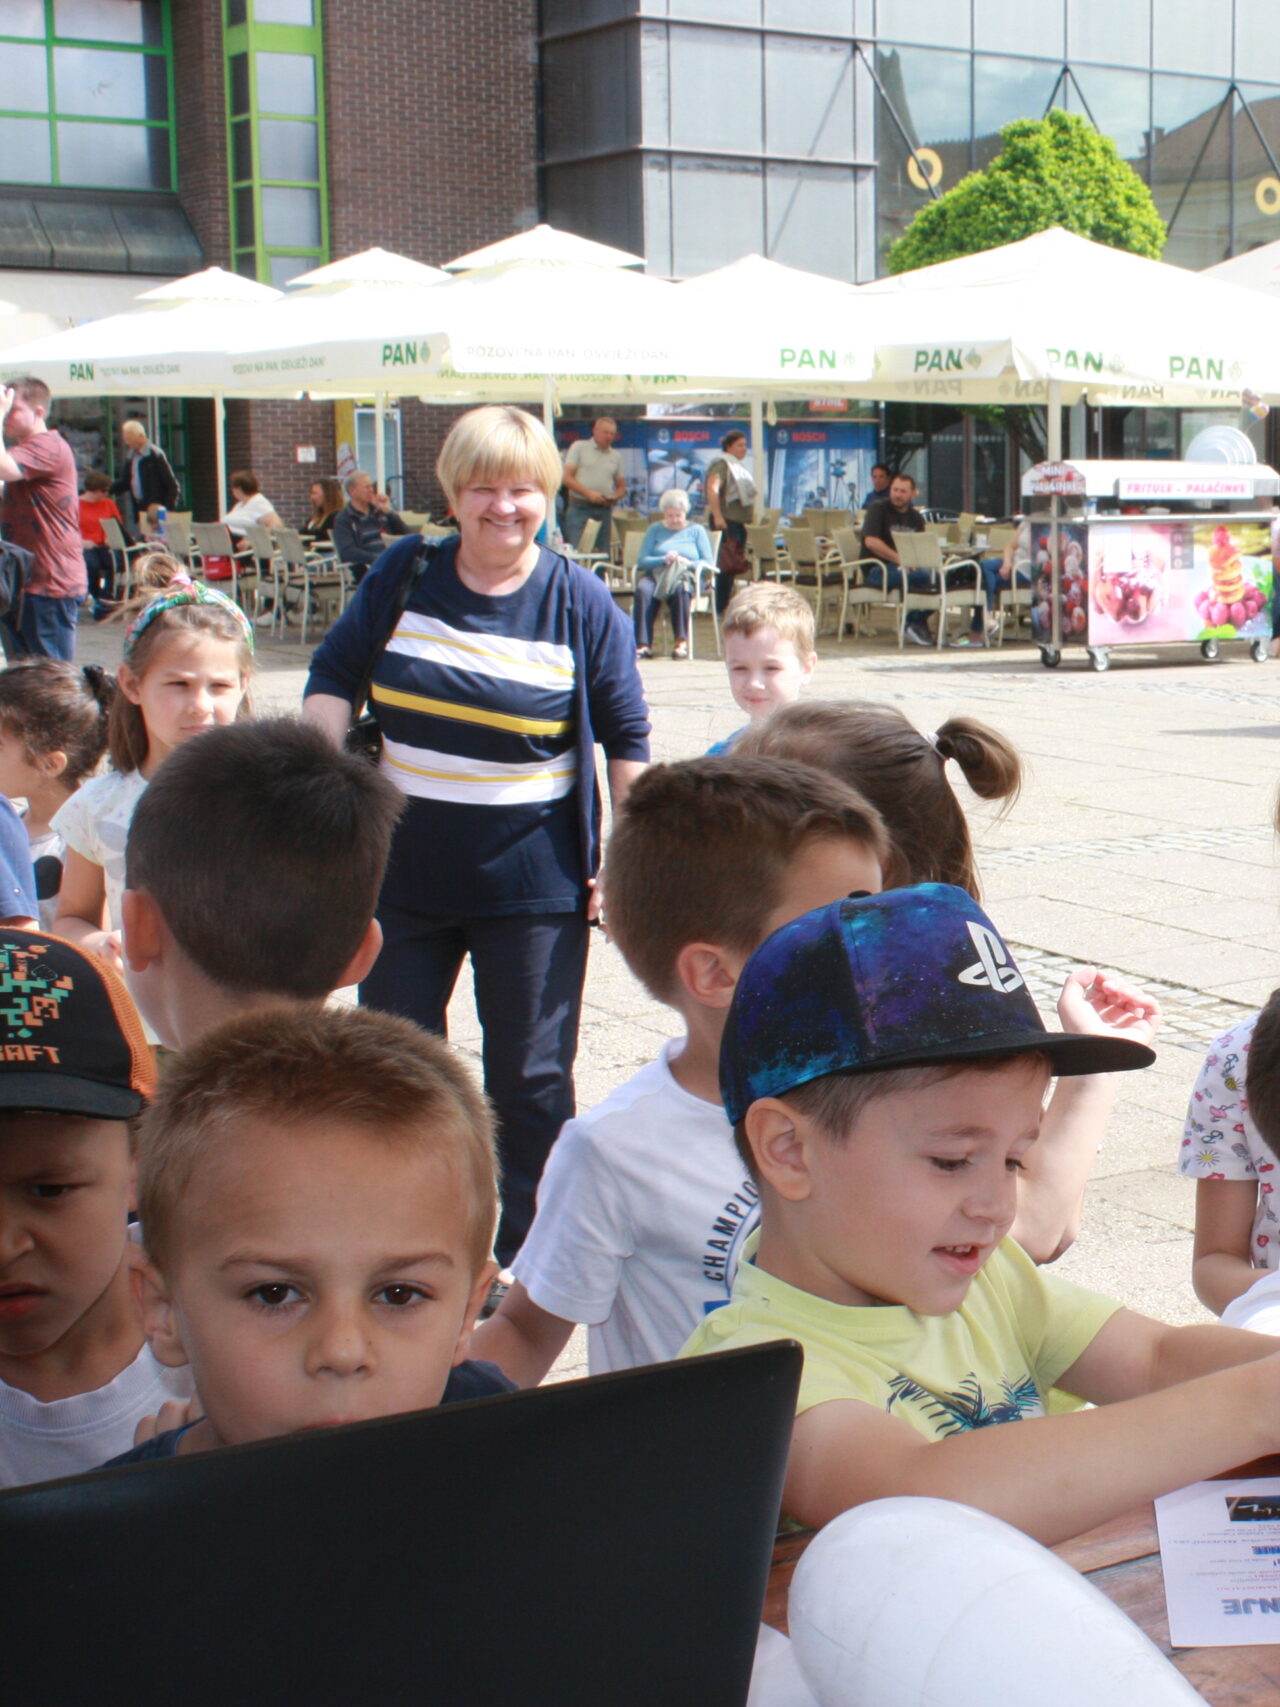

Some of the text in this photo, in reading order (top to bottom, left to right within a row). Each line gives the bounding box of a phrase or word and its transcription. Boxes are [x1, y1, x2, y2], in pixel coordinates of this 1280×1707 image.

[381, 342, 418, 367] PAN
[523, 347, 543, 358] NA
[780, 348, 836, 369] PAN
[914, 348, 963, 373] PAN
[1046, 348, 1104, 373] PAN
[70, 363, 95, 381] PAN
[1168, 355, 1224, 381] PAN
[673, 430, 711, 442] BOSCH
[791, 432, 828, 443] BOSCH
[1126, 481, 1174, 494] FRITULE
[1185, 480, 1247, 494] PALAČINKE
